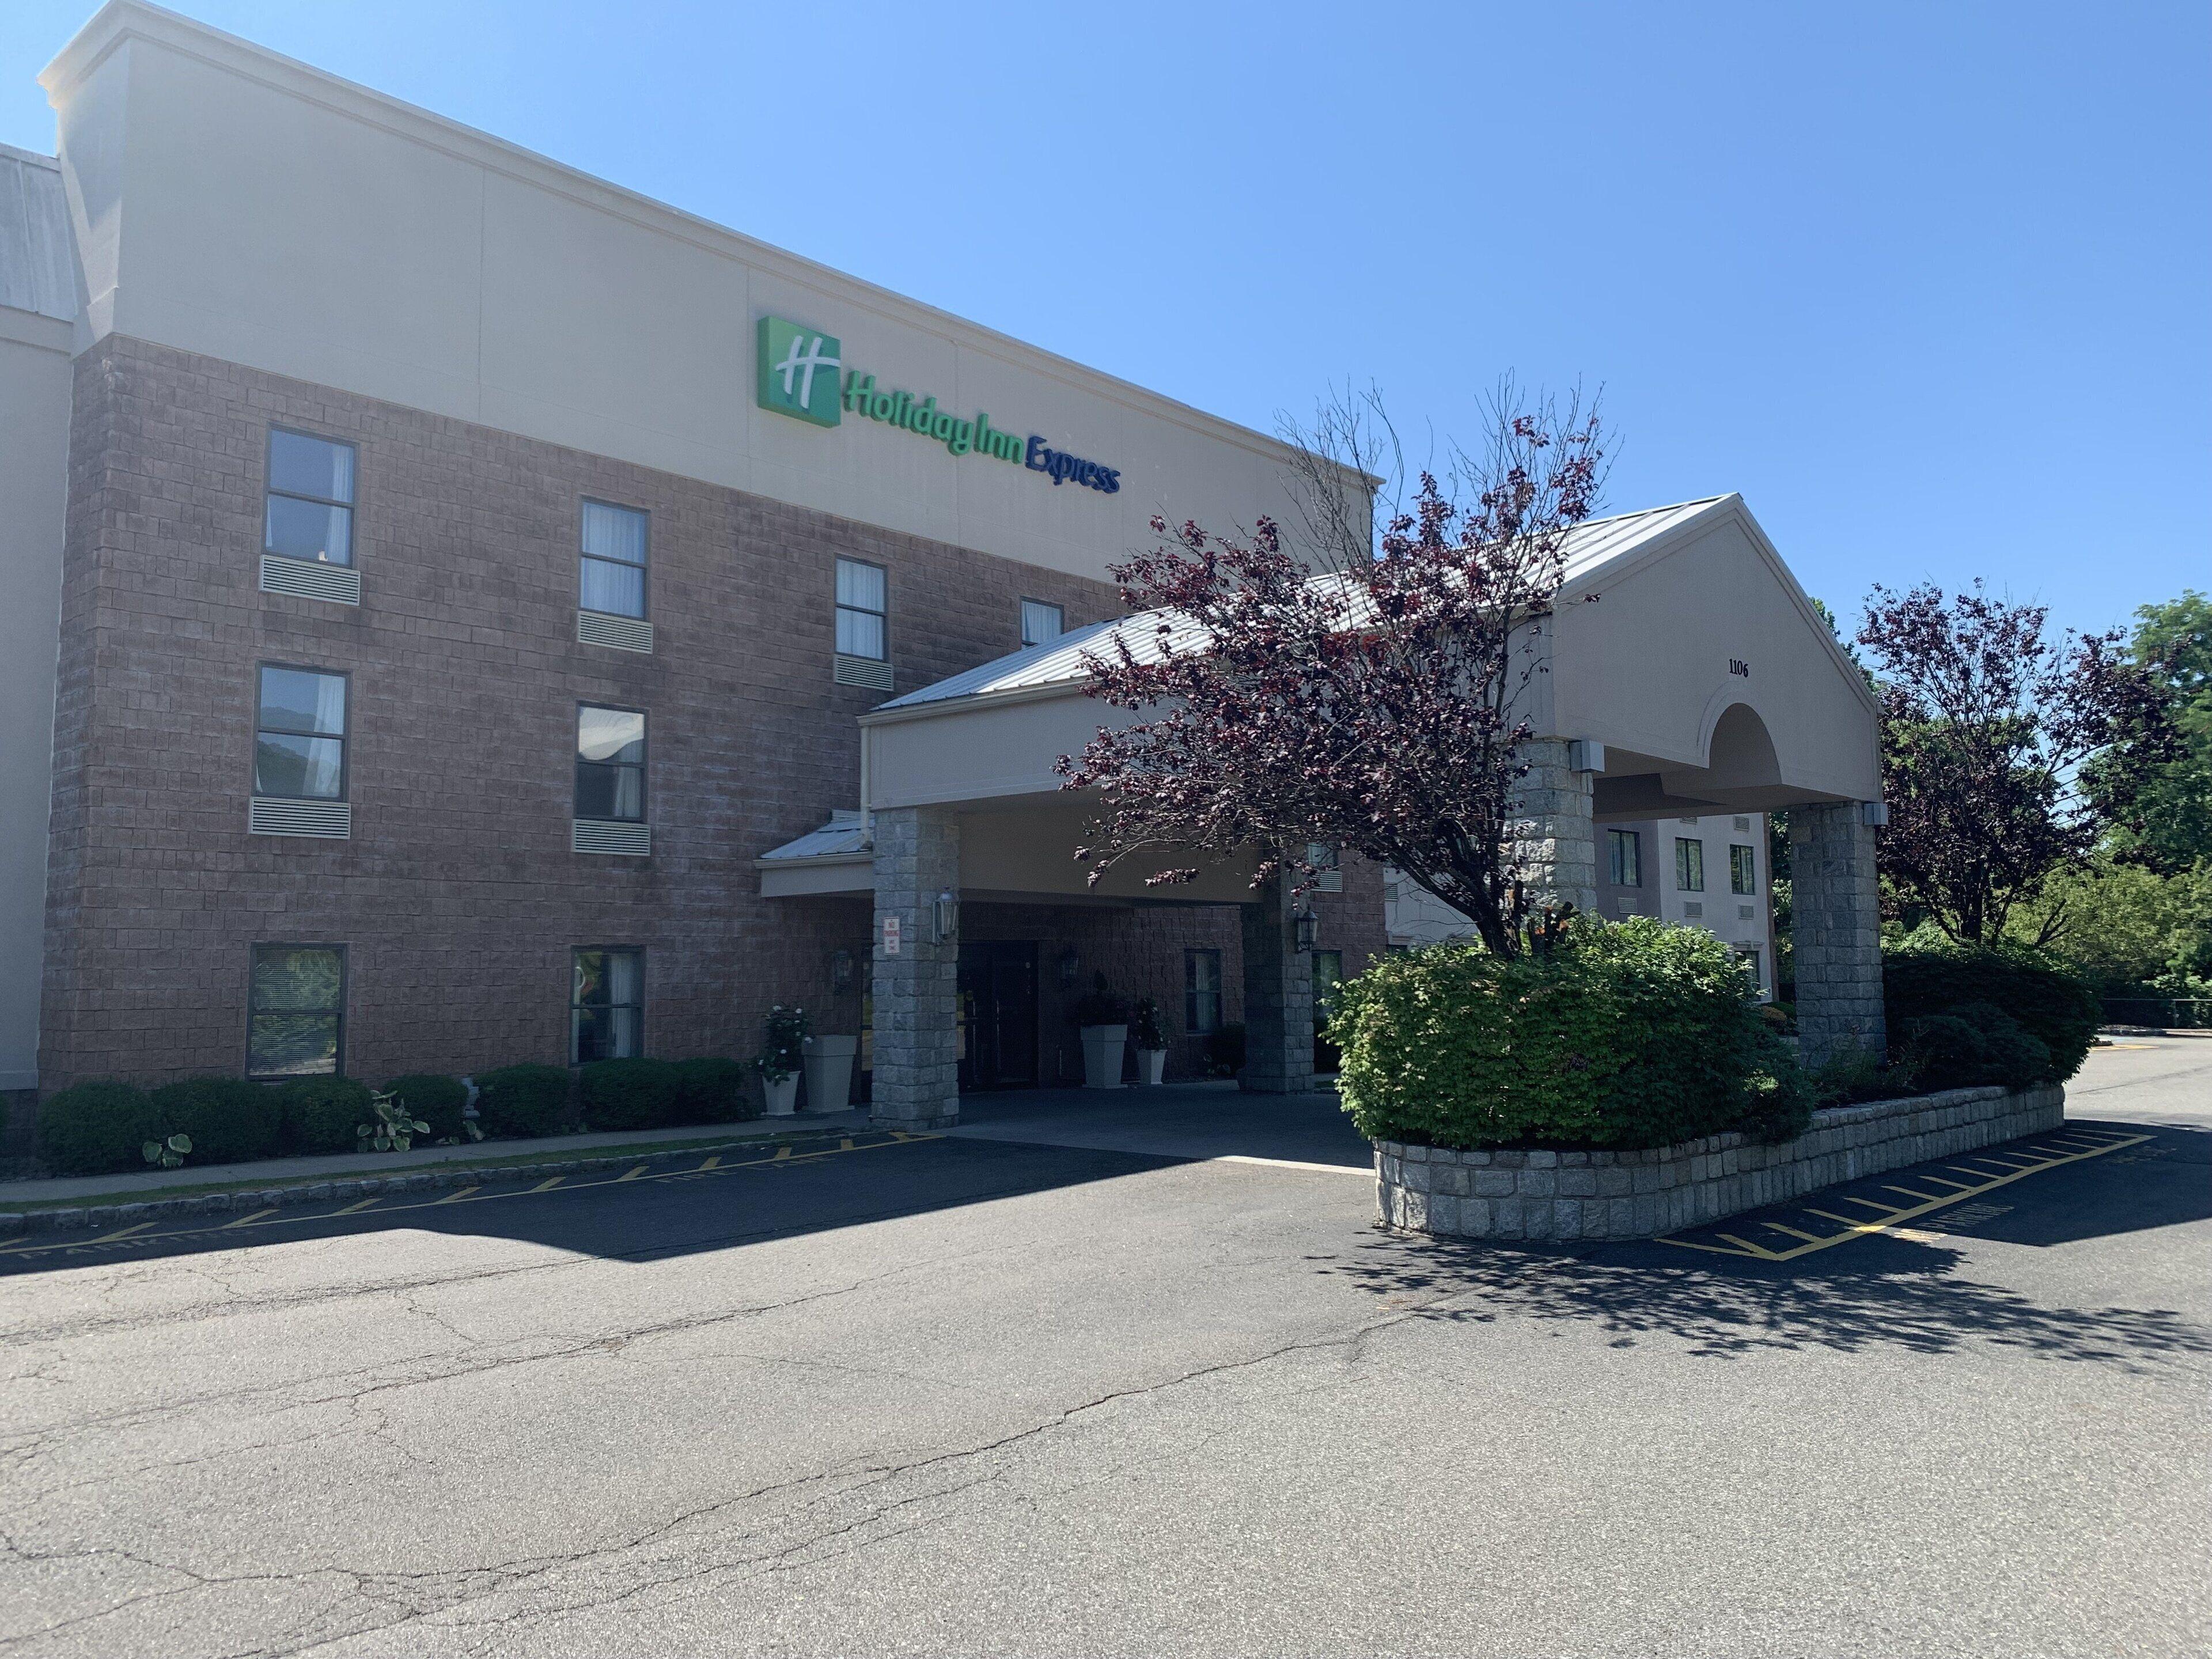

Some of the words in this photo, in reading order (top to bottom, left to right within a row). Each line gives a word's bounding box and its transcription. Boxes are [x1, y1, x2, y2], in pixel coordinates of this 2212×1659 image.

[844, 370, 974, 456] Holiday
[974, 414, 1024, 464] Inn
[1025, 435, 1121, 494] Express
[1729, 658, 1749, 677] 1106
[653, 1171, 737, 1183] FIRE
[746, 1157, 836, 1171] LANE
[17, 1229, 255, 1260] PARKING
